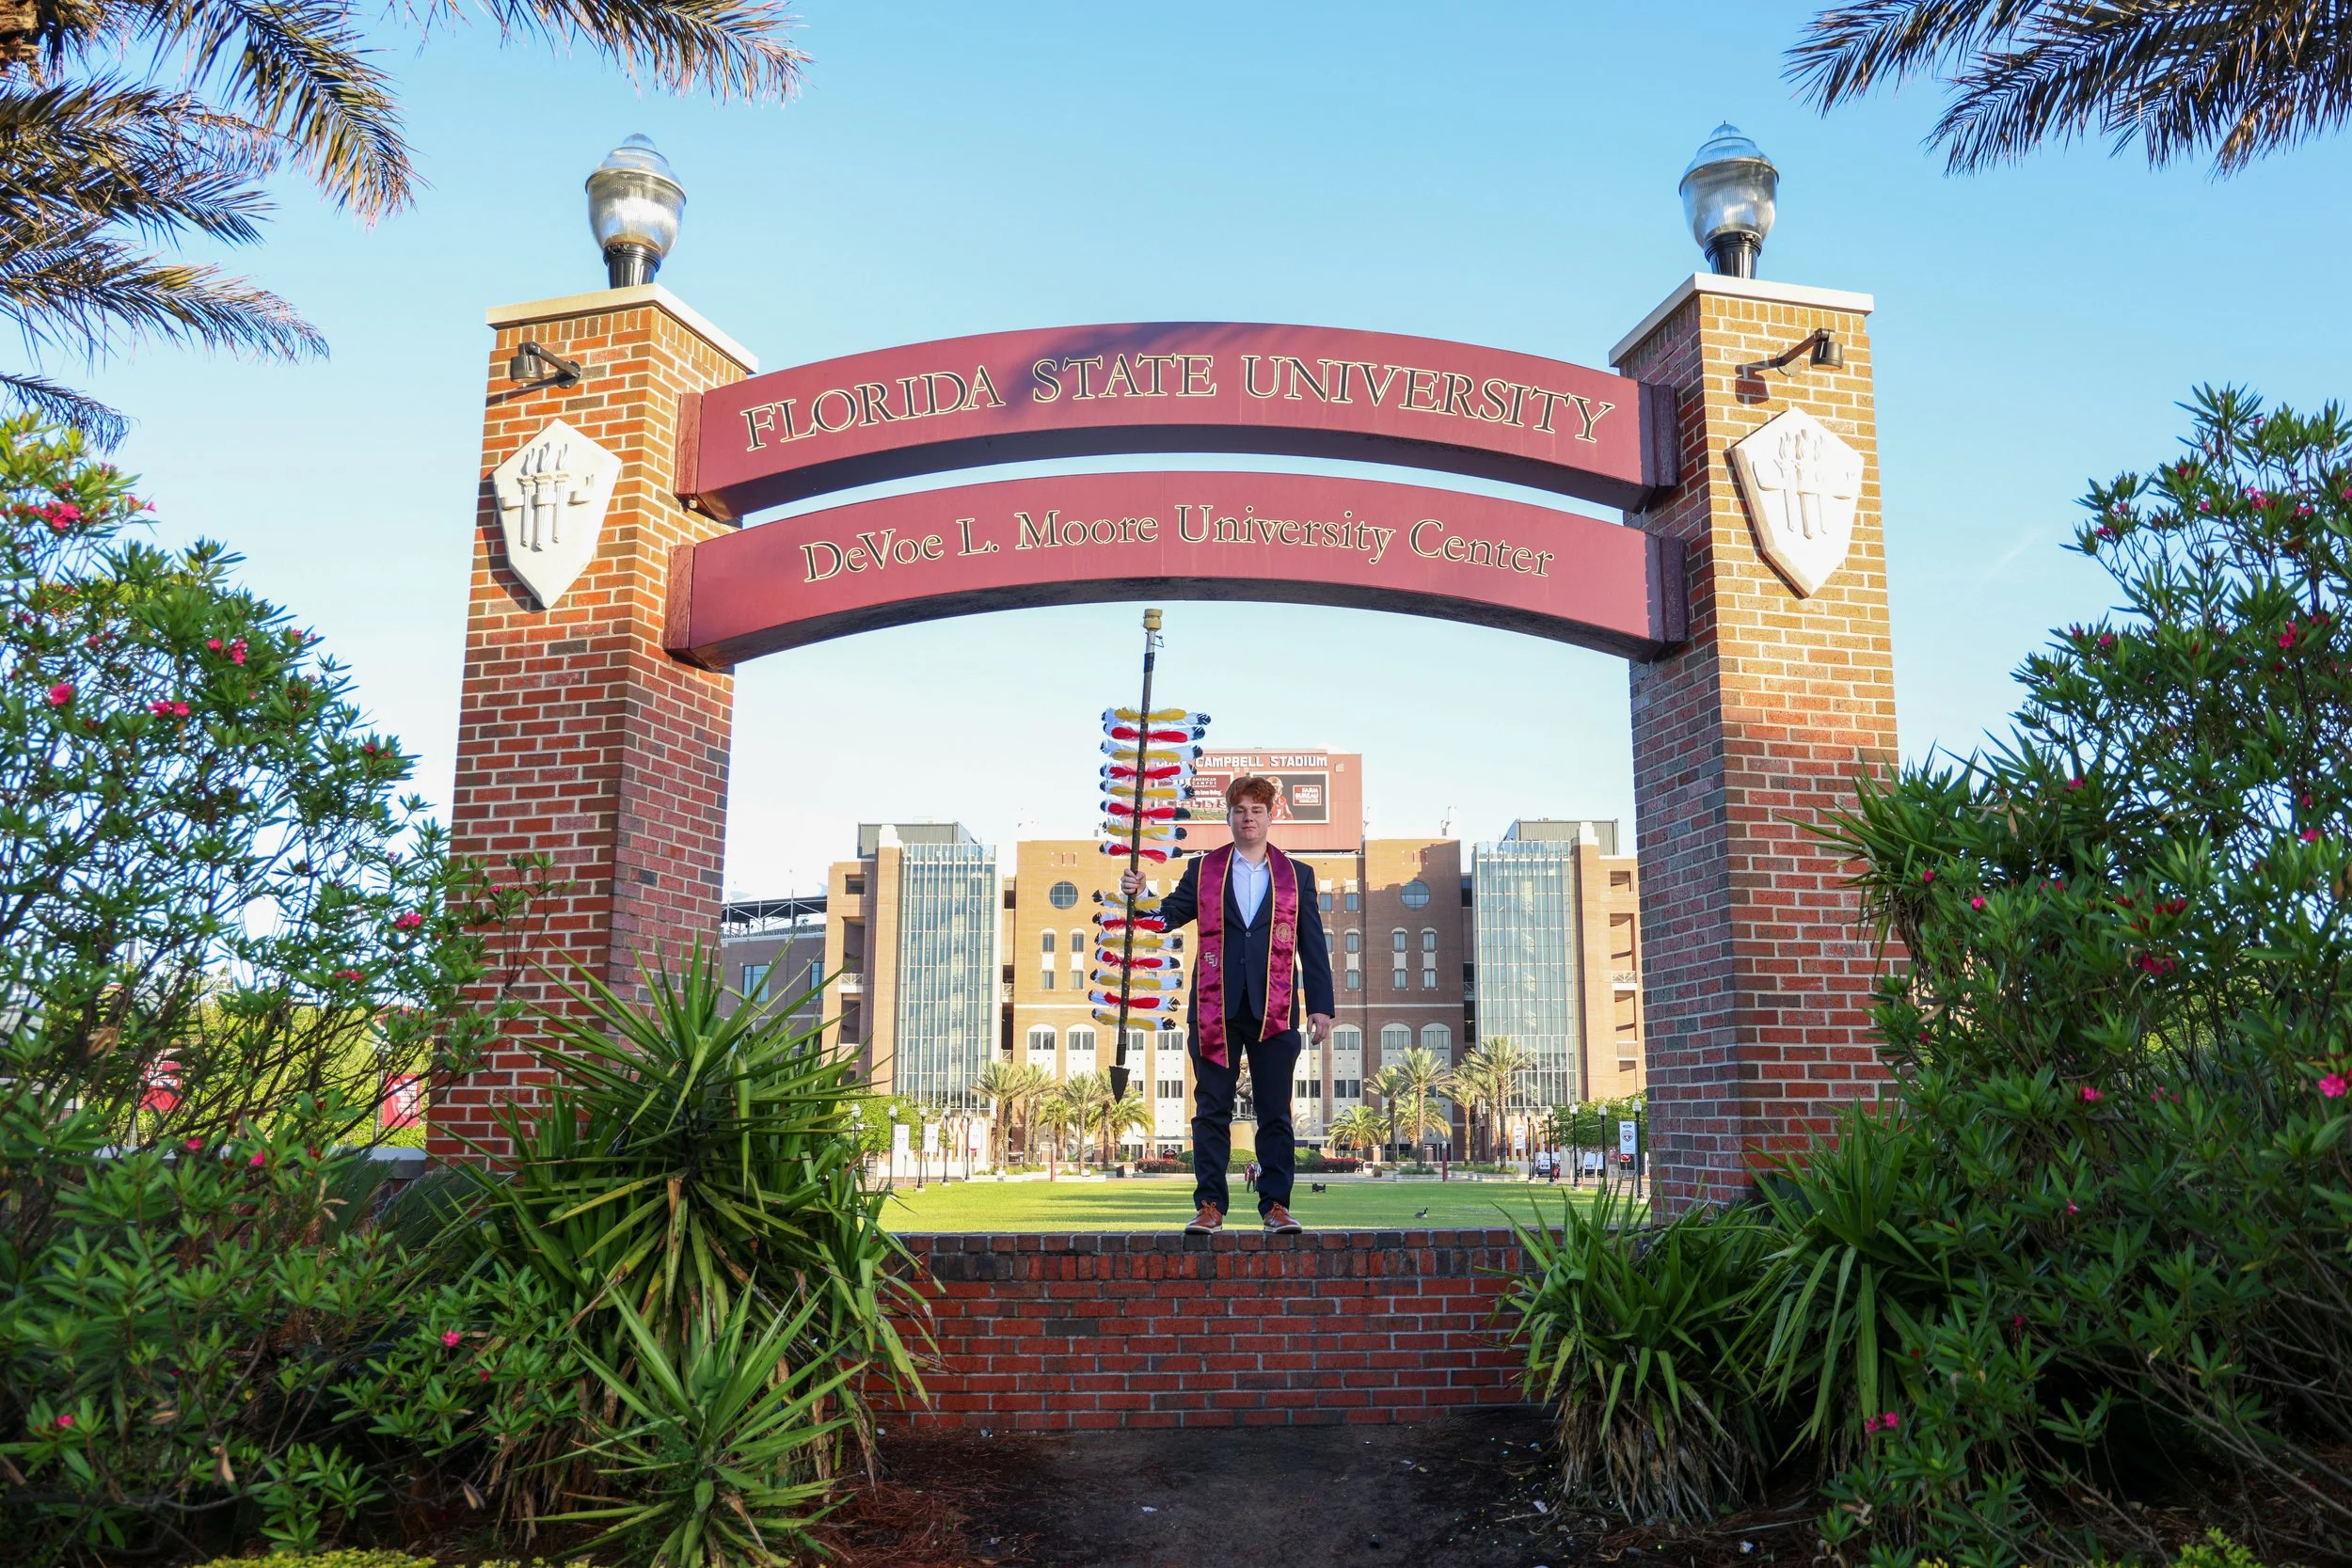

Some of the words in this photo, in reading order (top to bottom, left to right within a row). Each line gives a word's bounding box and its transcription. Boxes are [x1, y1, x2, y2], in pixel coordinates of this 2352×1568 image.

[740, 365, 1006, 451] FLORIDA
[1032, 354, 1216, 403] STATE
[1242, 355, 1615, 443] UNIVERSITY
[800, 528, 944, 583] DeVoe
[956, 517, 1000, 556] L.
[1013, 509, 1158, 550] Moore
[1174, 504, 1396, 564] University
[1408, 517, 1555, 578] Center
[1195, 756, 1263, 768] CAMPBELL
[1270, 755, 1327, 767] STADIUM
